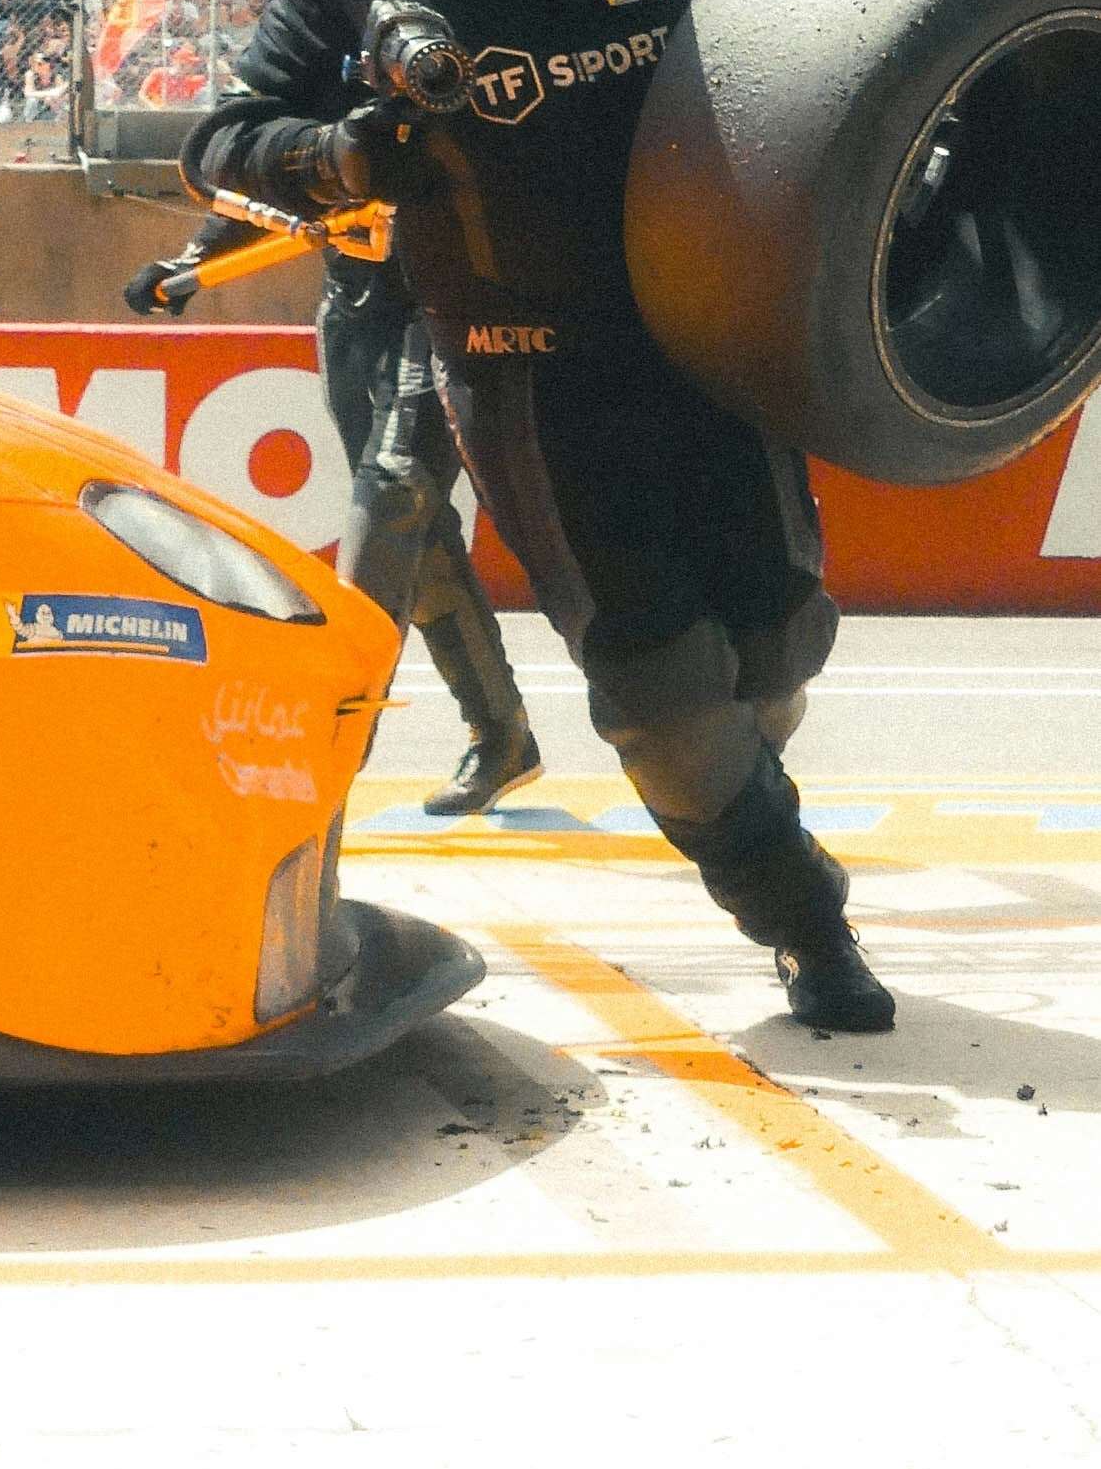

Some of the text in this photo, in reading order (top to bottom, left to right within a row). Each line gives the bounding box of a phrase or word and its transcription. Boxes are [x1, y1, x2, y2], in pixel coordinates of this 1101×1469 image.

[475, 65, 526, 107] TF
[465, 325, 556, 354] MRTC
[66, 613, 189, 643] MICHELIN
